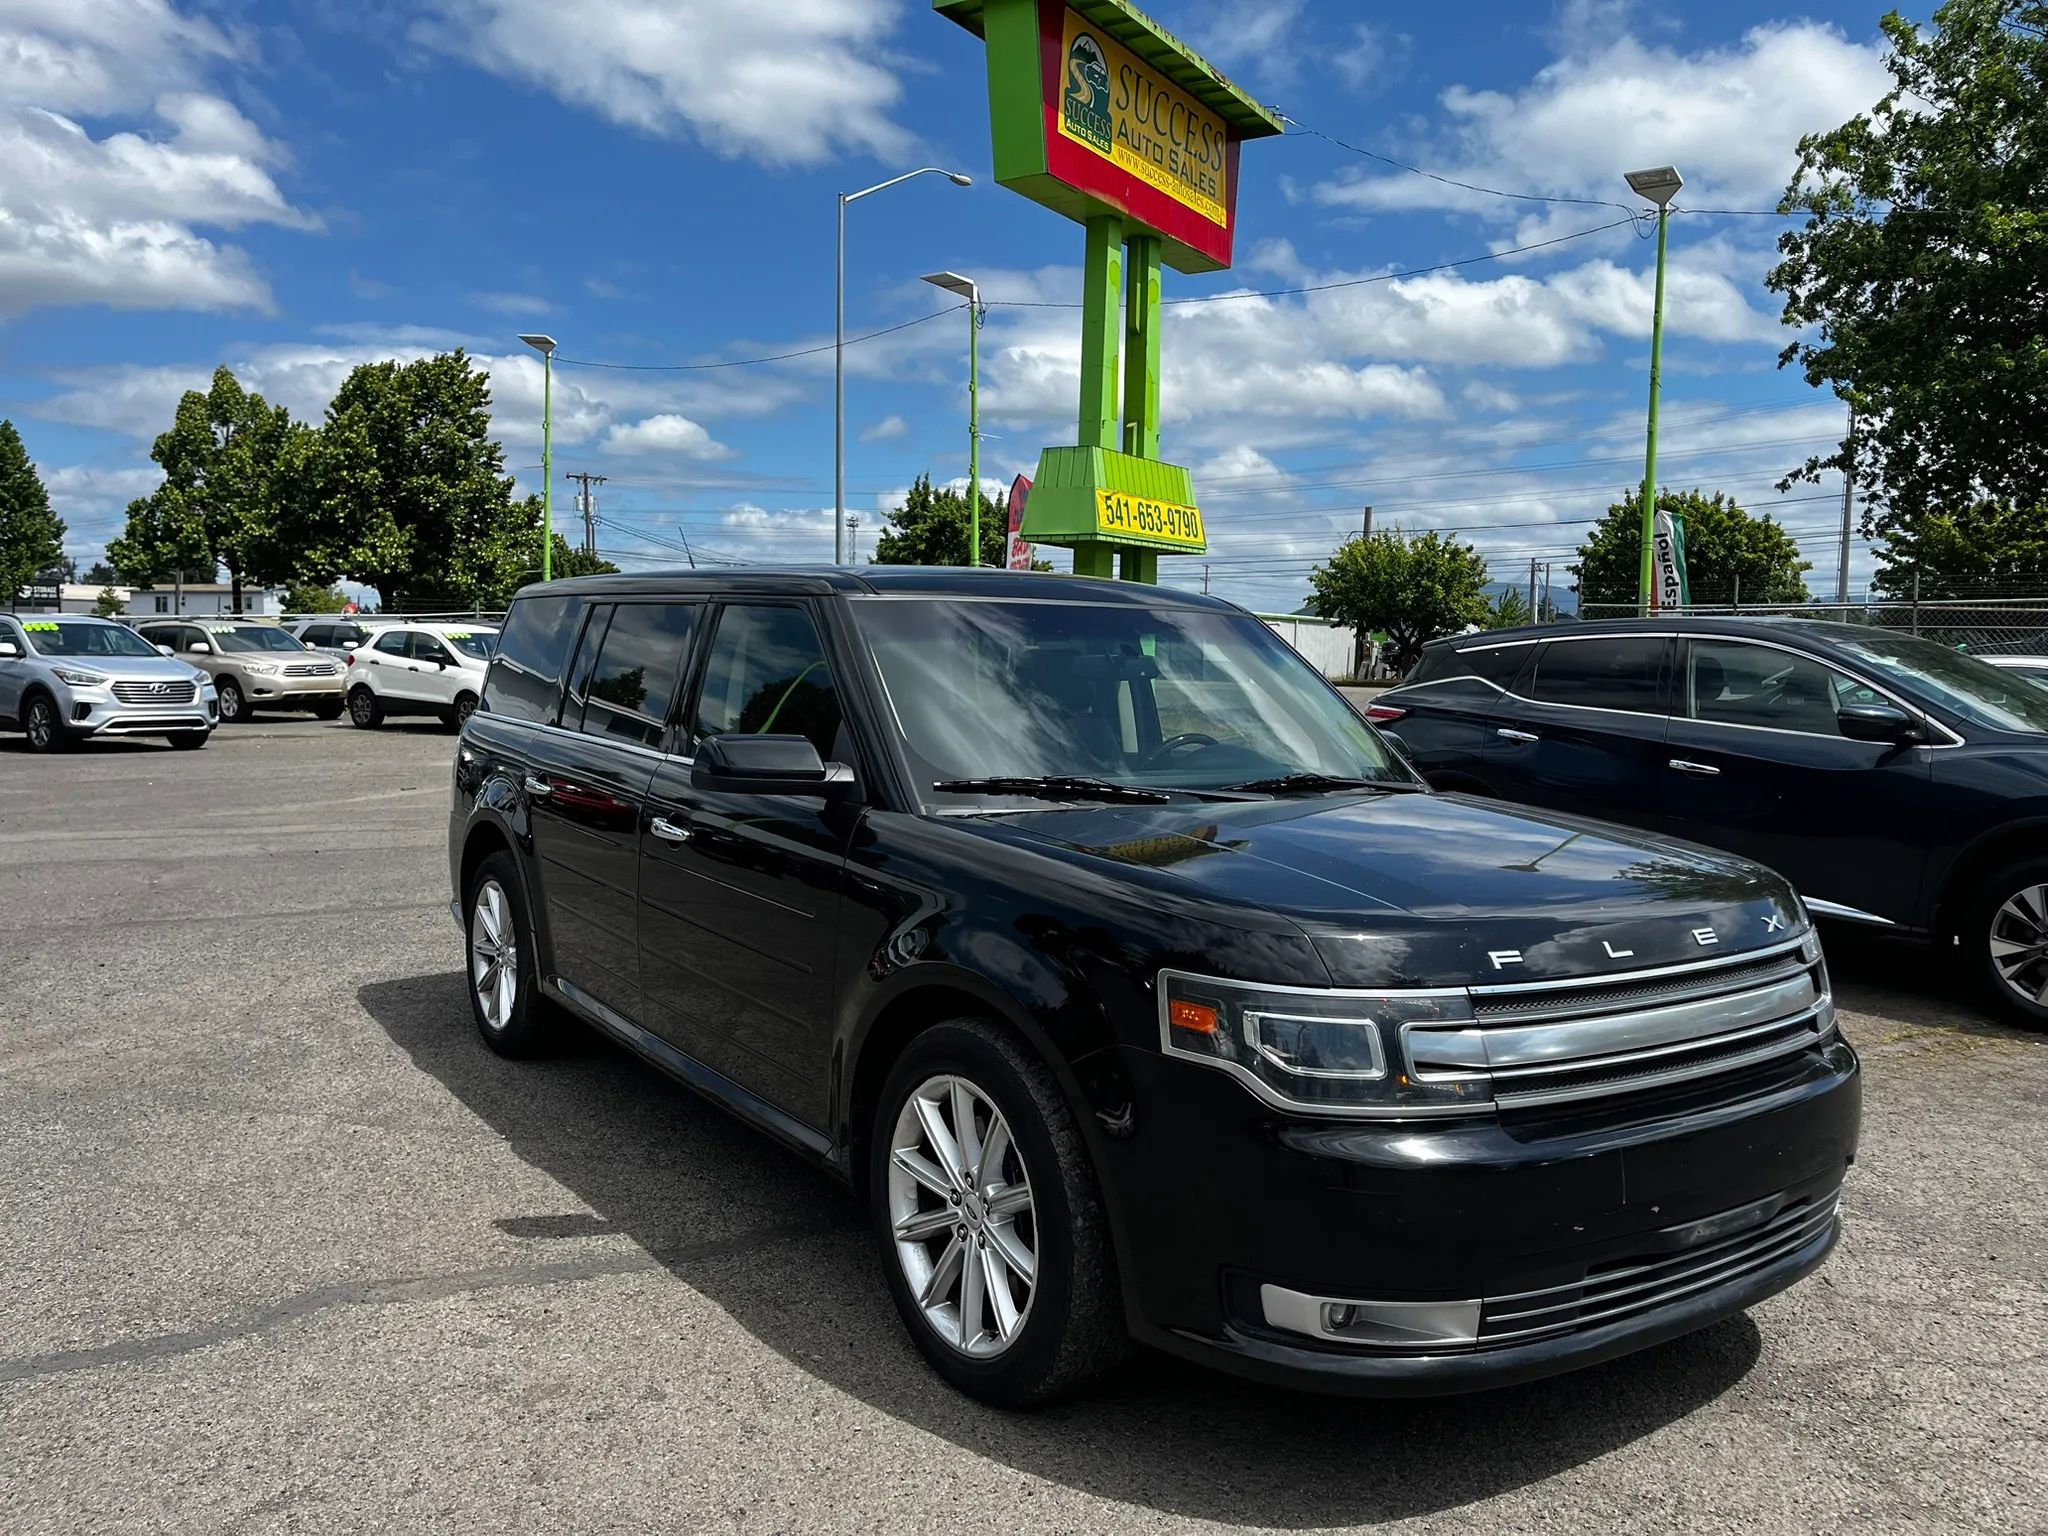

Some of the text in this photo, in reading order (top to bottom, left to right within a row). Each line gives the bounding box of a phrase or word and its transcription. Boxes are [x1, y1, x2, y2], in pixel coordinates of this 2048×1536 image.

[1065, 98, 1111, 139] SUCCESS
[1066, 118, 1109, 151] AUTO SALES
[1116, 64, 1223, 172] SUCCESS
[1117, 118, 1216, 198] AUTO SALES
[1117, 147, 1220, 217] www.success-autosales.com
[1105, 495, 1198, 539] 541-653-9790
[1653, 533, 1679, 610] Español
[1488, 914, 1784, 970] FLEX
